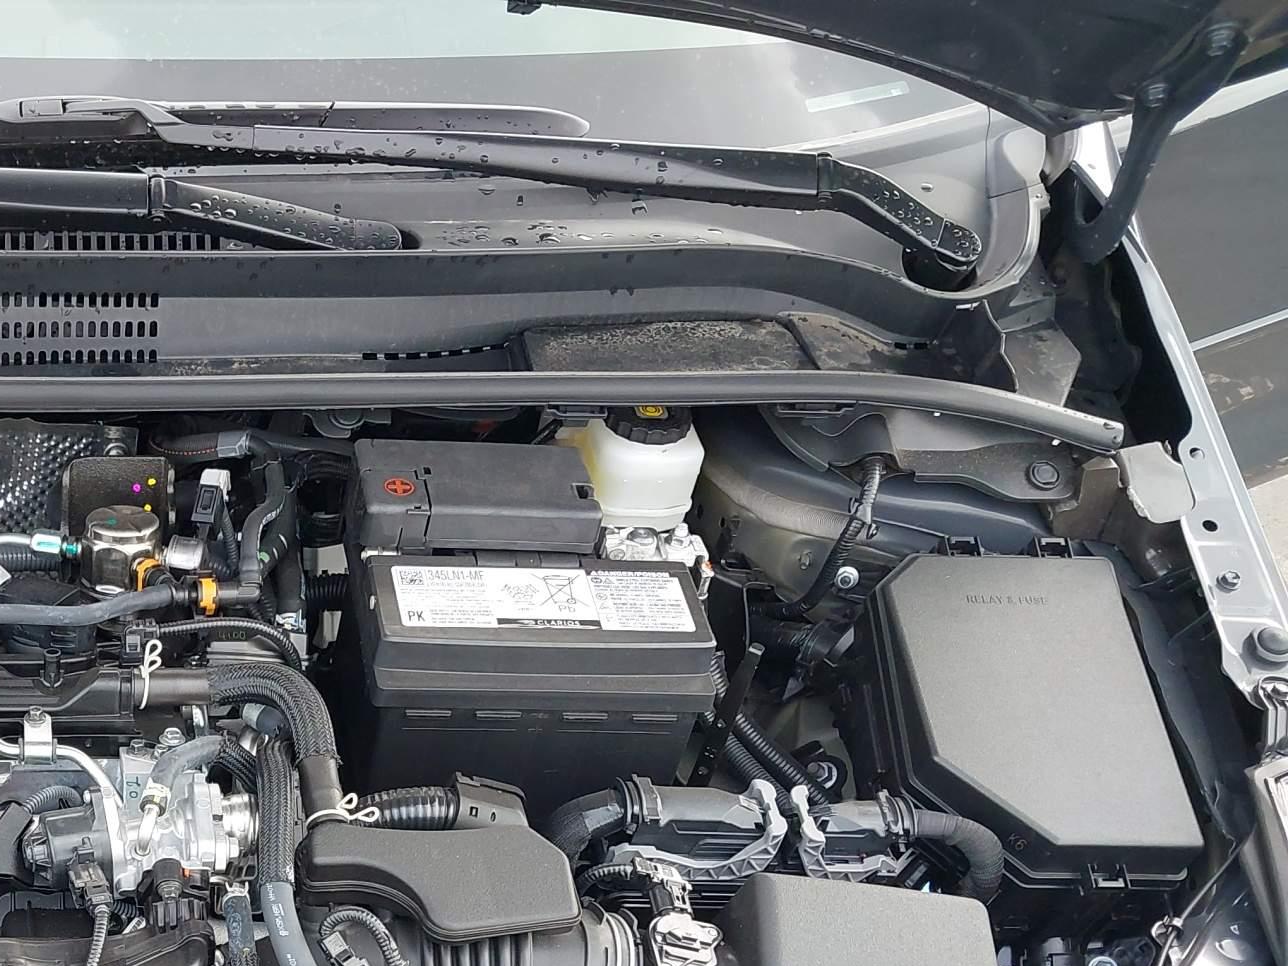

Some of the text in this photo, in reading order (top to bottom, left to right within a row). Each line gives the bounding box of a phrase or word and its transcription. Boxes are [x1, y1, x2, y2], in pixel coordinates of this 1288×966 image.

[428, 570, 484, 581] 345LN1-MF
[966, 595, 1002, 604] RELAY
[1019, 596, 1048, 605] FUSE
[407, 610, 425, 622] PK
[537, 619, 580, 627] CLARIOS
